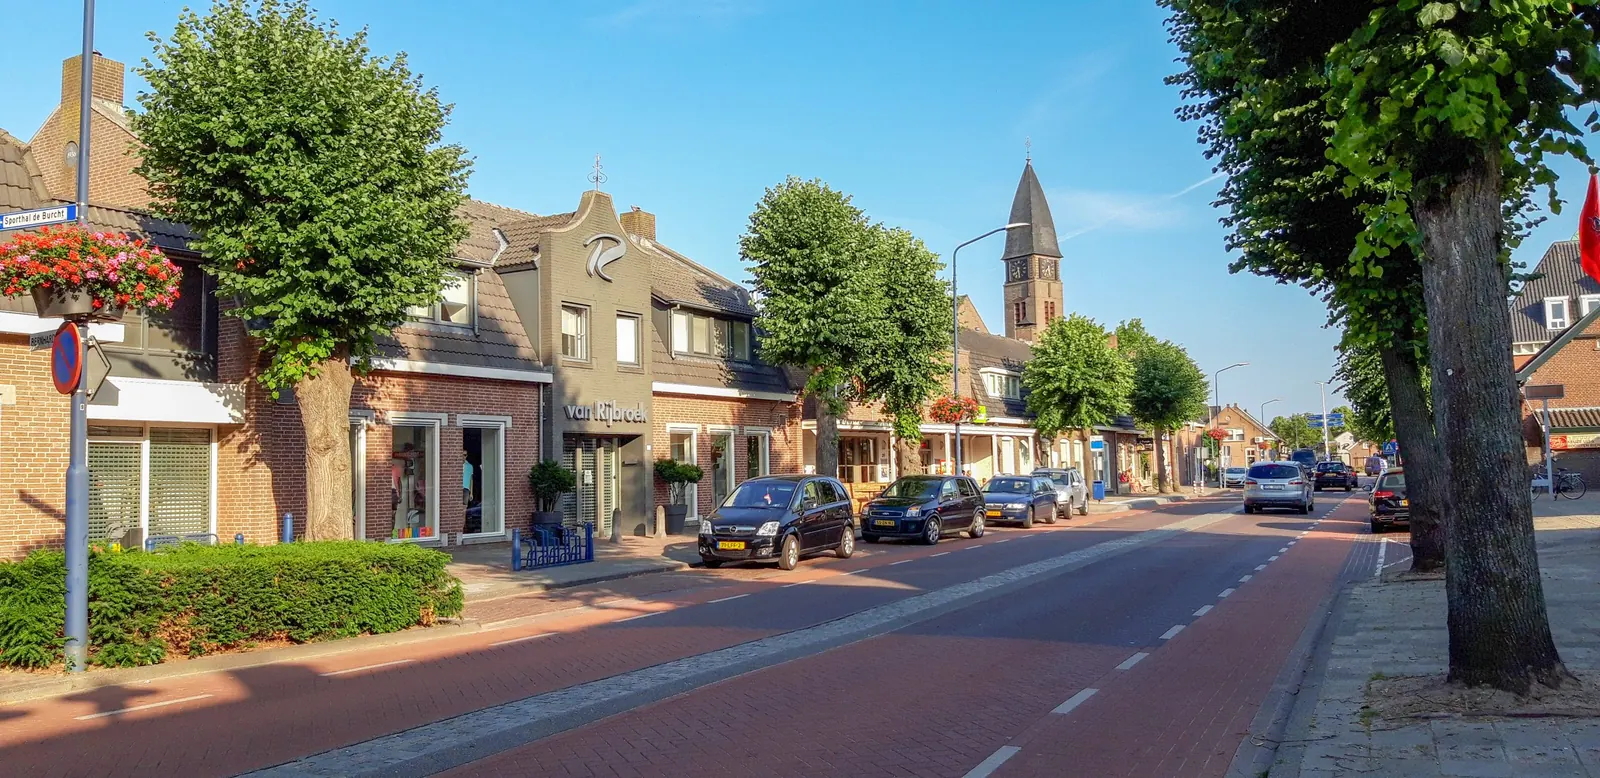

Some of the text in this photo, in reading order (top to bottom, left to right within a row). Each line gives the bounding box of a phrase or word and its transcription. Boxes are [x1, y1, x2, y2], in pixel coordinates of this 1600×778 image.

[4, 210, 65, 226] Sporthal de Burcht
[564, 400, 648, 427] van Rijbroek
